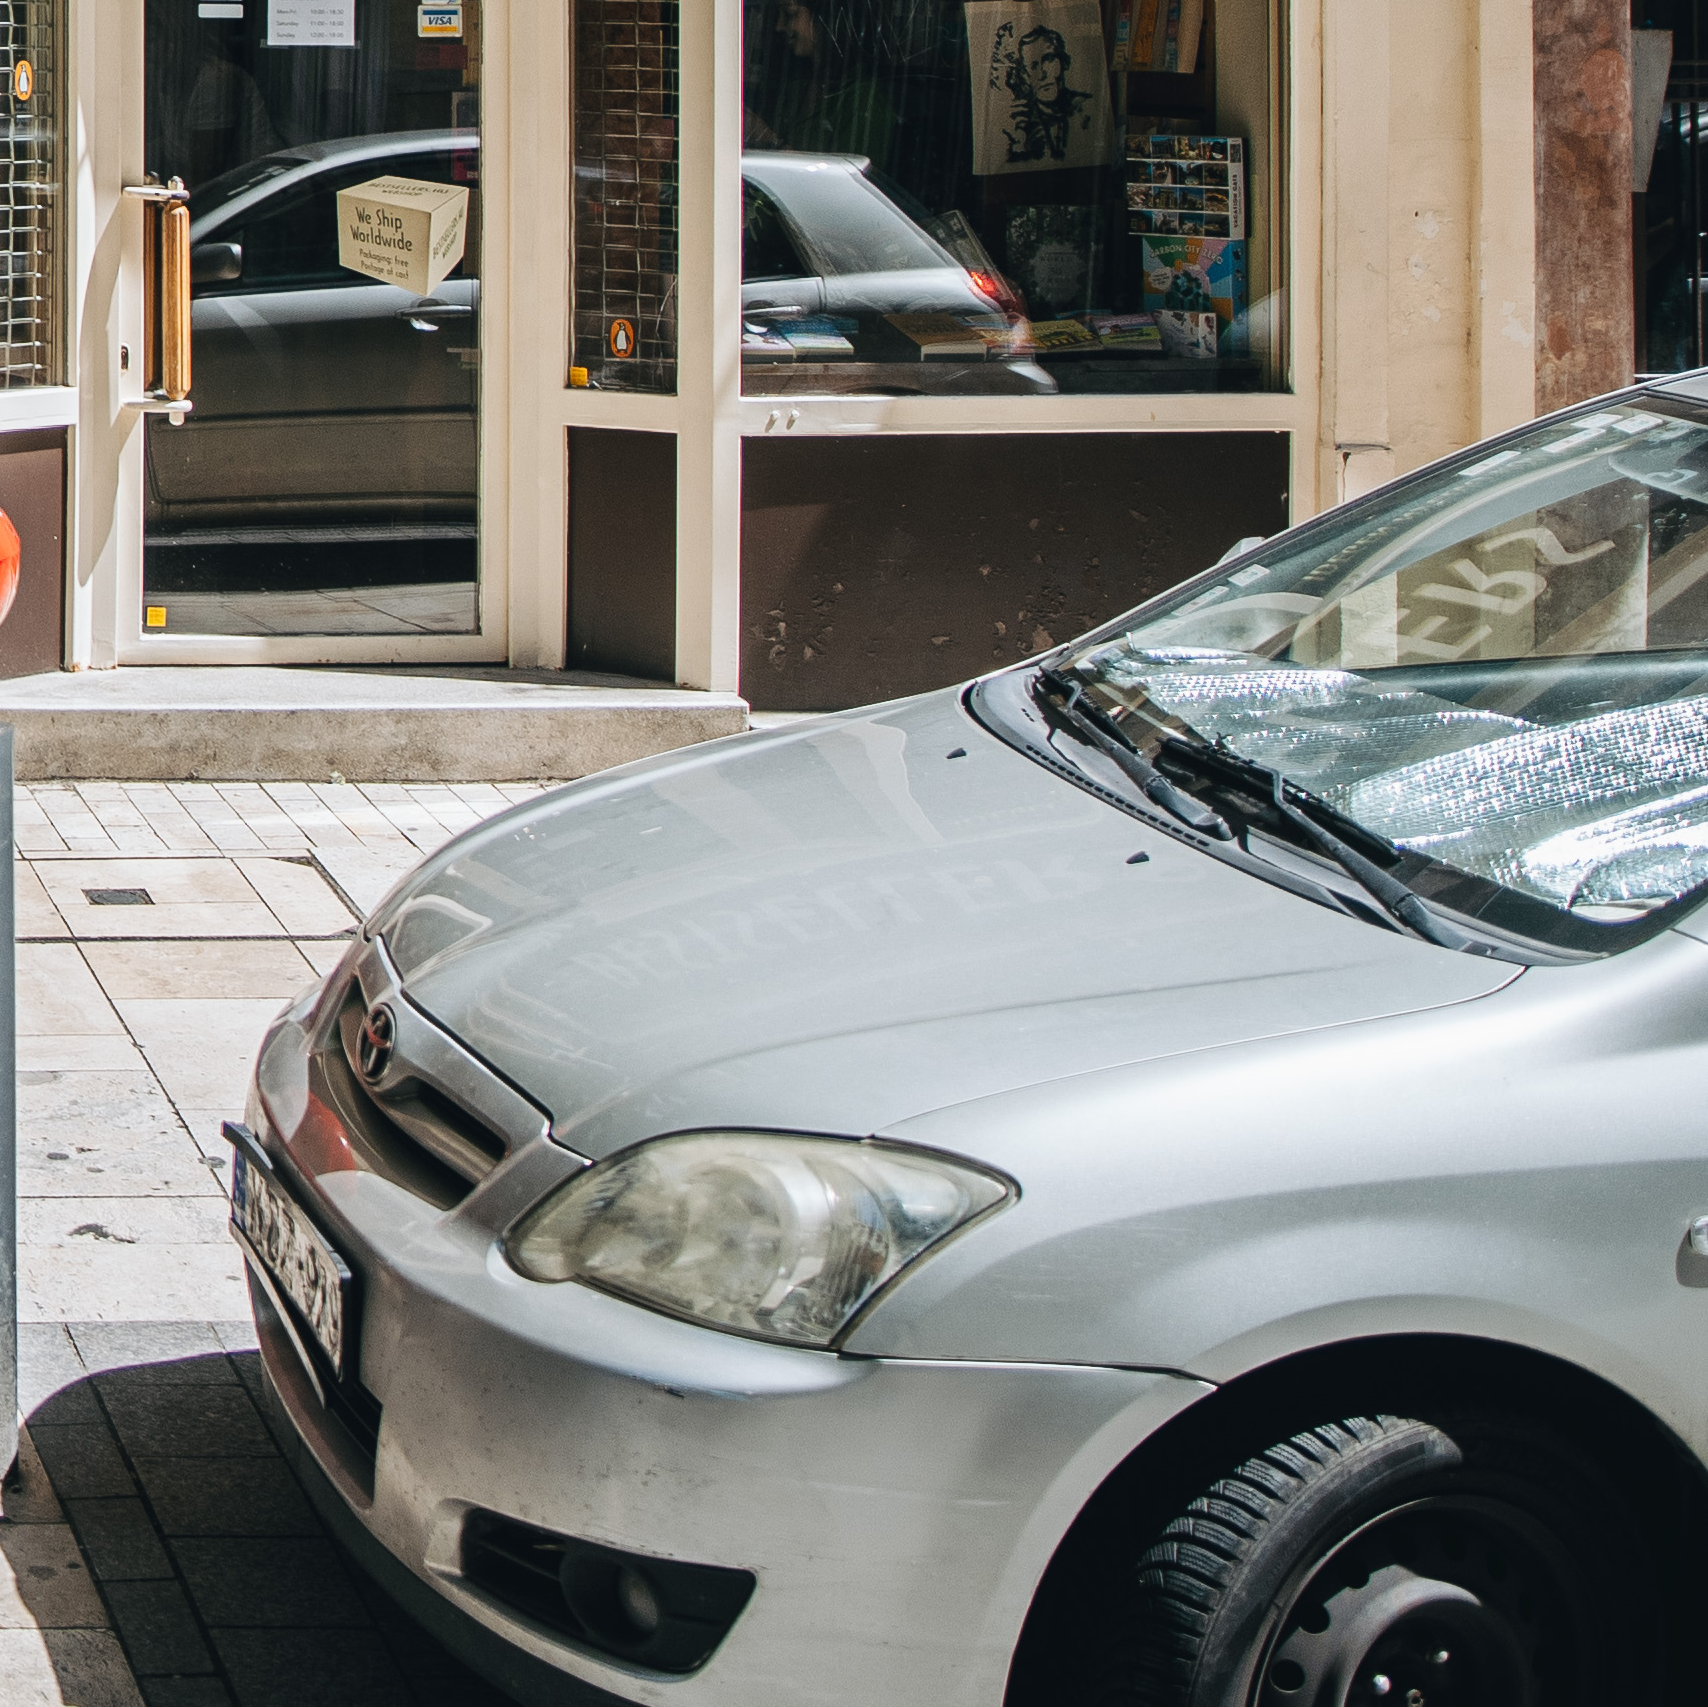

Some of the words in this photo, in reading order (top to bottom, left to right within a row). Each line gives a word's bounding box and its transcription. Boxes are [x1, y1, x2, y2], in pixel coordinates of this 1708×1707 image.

[428, 16, 453, 26] VISA
[355, 206, 372, 226] We
[376, 208, 403, 234] Ship
[349, 224, 414, 252] Worldwide
